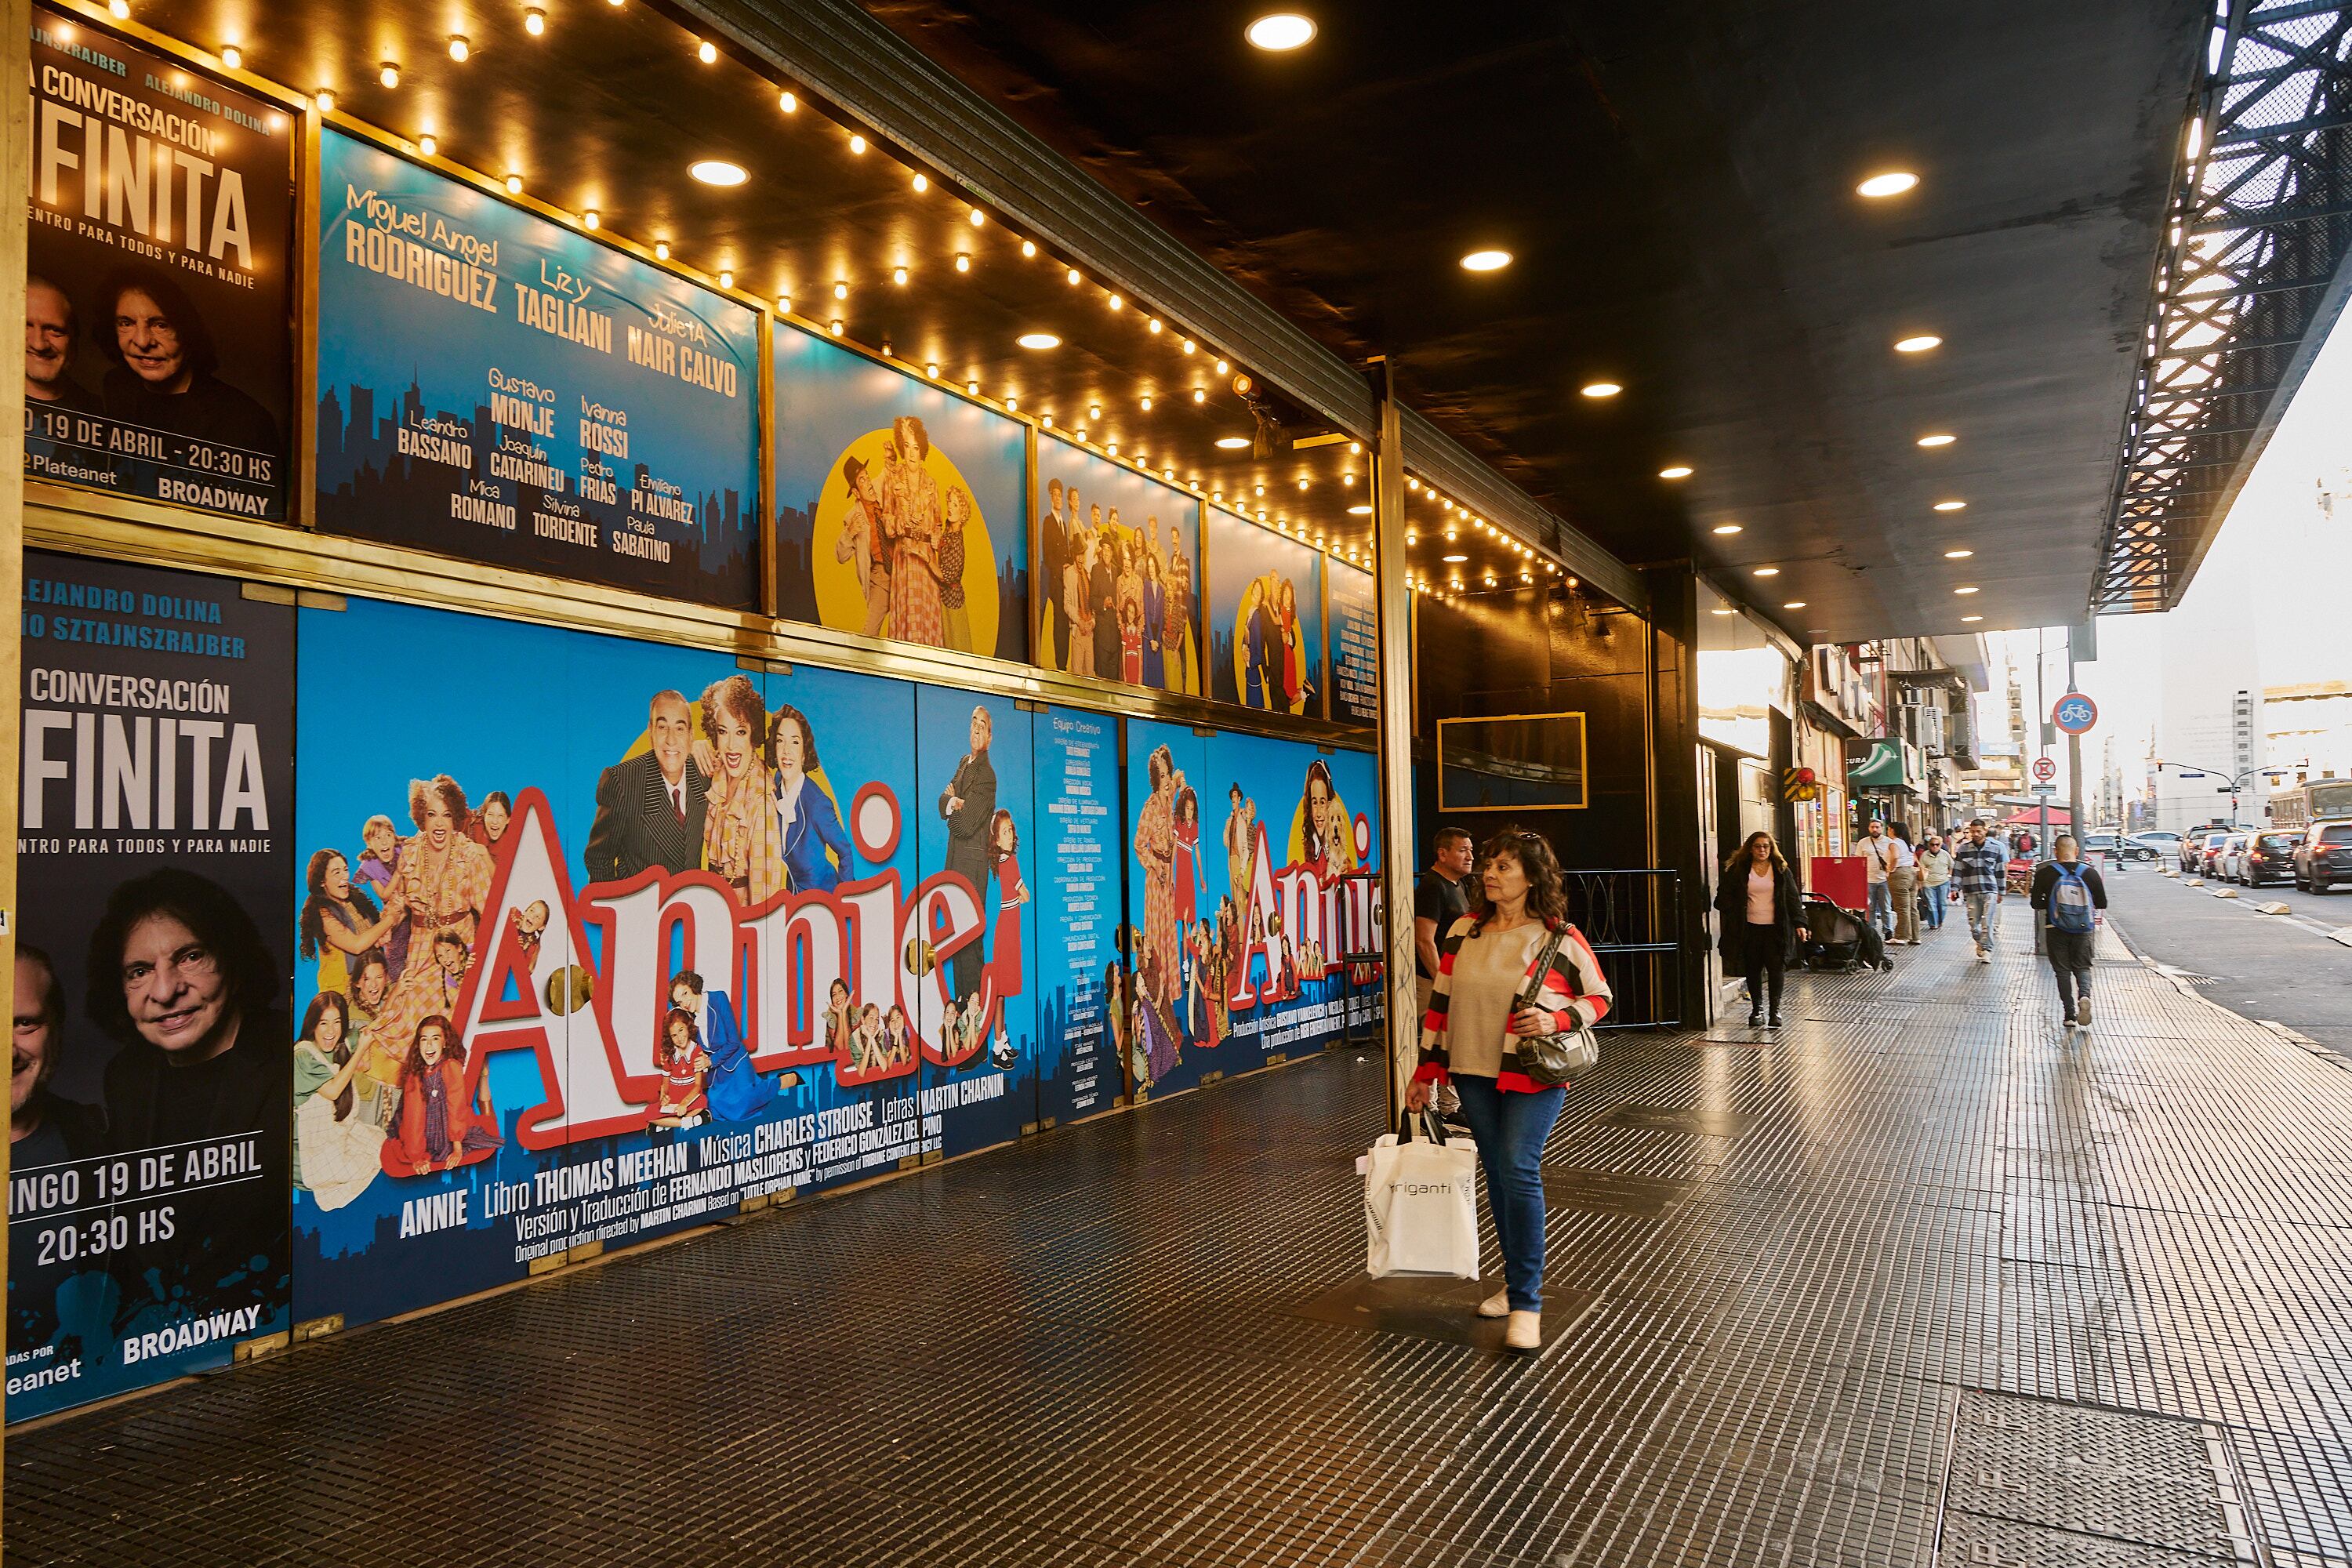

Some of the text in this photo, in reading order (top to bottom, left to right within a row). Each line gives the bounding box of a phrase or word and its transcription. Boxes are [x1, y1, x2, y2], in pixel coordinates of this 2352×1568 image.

[42, 65, 216, 157] CONVERSACIÓN
[145, 74, 220, 116] ALEJANDRO
[224, 106, 270, 136] DOLINA
[28, 95, 253, 270] FINITA
[347, 184, 499, 267] Miguel Angel
[78, 222, 114, 245] PARA
[120, 235, 162, 260] TODOS
[168, 251, 176, 264] Y
[181, 255, 212, 277] PARA
[218, 271, 254, 289] NADIE
[347, 220, 498, 313] RODRIGUEZ
[541, 259, 591, 303] Lizy
[514, 282, 612, 354] TAGLIANI
[628, 325, 738, 397] NAIR CALVO
[488, 368, 555, 403] Gustavo
[410, 410, 467, 438] Leandro
[492, 393, 555, 438] MONJE
[582, 395, 626, 426] Ivanna
[43, 413, 69, 439] 19
[77, 419, 103, 447] DE
[109, 427, 168, 460] ABRIL
[188, 445, 243, 476] 20:30
[249, 459, 271, 481] HS
[397, 428, 471, 470] BASSANO
[580, 419, 628, 459] ROSSI
[33, 455, 117, 485] Plateanet
[490, 452, 564, 492] CATARINEU
[581, 458, 614, 477] Pedro
[640, 474, 681, 496] Emiliano
[158, 477, 269, 516] BROADWAY
[470, 480, 499, 499] Mica
[543, 495, 579, 517] Silvina
[580, 475, 615, 506] FRIAS
[631, 488, 693, 524] PI ALVAREZ
[451, 493, 516, 530] ROMANO
[533, 512, 597, 548] TORDENTE
[627, 516, 654, 536] Paula
[612, 531, 670, 564] SABATINO
[23, 579, 222, 625] EJANDRO DOLINA
[53, 616, 246, 659] SZTAJNSZRAJBER
[30, 667, 230, 714] CONVERSACIÓN
[1053, 717, 1101, 735] Equipo Creativo
[23, 709, 270, 831] FINITA
[68, 838, 109, 854] PARA
[116, 838, 165, 854] TODOS
[172, 839, 180, 853] Y
[187, 839, 223, 854] PARA
[230, 839, 271, 854] NADIE
[379, 781, 997, 1178] Annie
[93, 1162, 129, 1200] 19
[140, 1153, 175, 1192] DE
[184, 1140, 262, 1183] ABRIL
[400, 1073, 1004, 1240] ANNIE Libro THOMAS MEEHAN Música CHARLES STROUSE Letras MARTIN CHARNIN
[515, 1114, 942, 1242] Versión y Traducción de FERNANDO MASLLORENS y FEDERICO GONZÁLEZ DEL PINO
[515, 1238, 549, 1263] Original
[596, 1218, 628, 1242] directed
[630, 1215, 639, 1235] by
[640, 1204, 671, 1230] MARTIN
[672, 1196, 706, 1221] CHARNIN
[708, 1191, 728, 1211] Based
[728, 1191, 739, 1205] on
[764, 1177, 791, 1196] ORPHAN
[815, 1167, 823, 1182] by
[824, 1160, 855, 1181] permission
[855, 1157, 862, 1171] of
[862, 1151, 886, 1169] TRIBUNE
[886, 1145, 910, 1163] CONTENT
[933, 1138, 942, 1150] LLC
[38, 1206, 176, 1266] 20:30 HS
[32, 1345, 53, 1359] POR
[123, 1305, 261, 1365] BROADWAY
